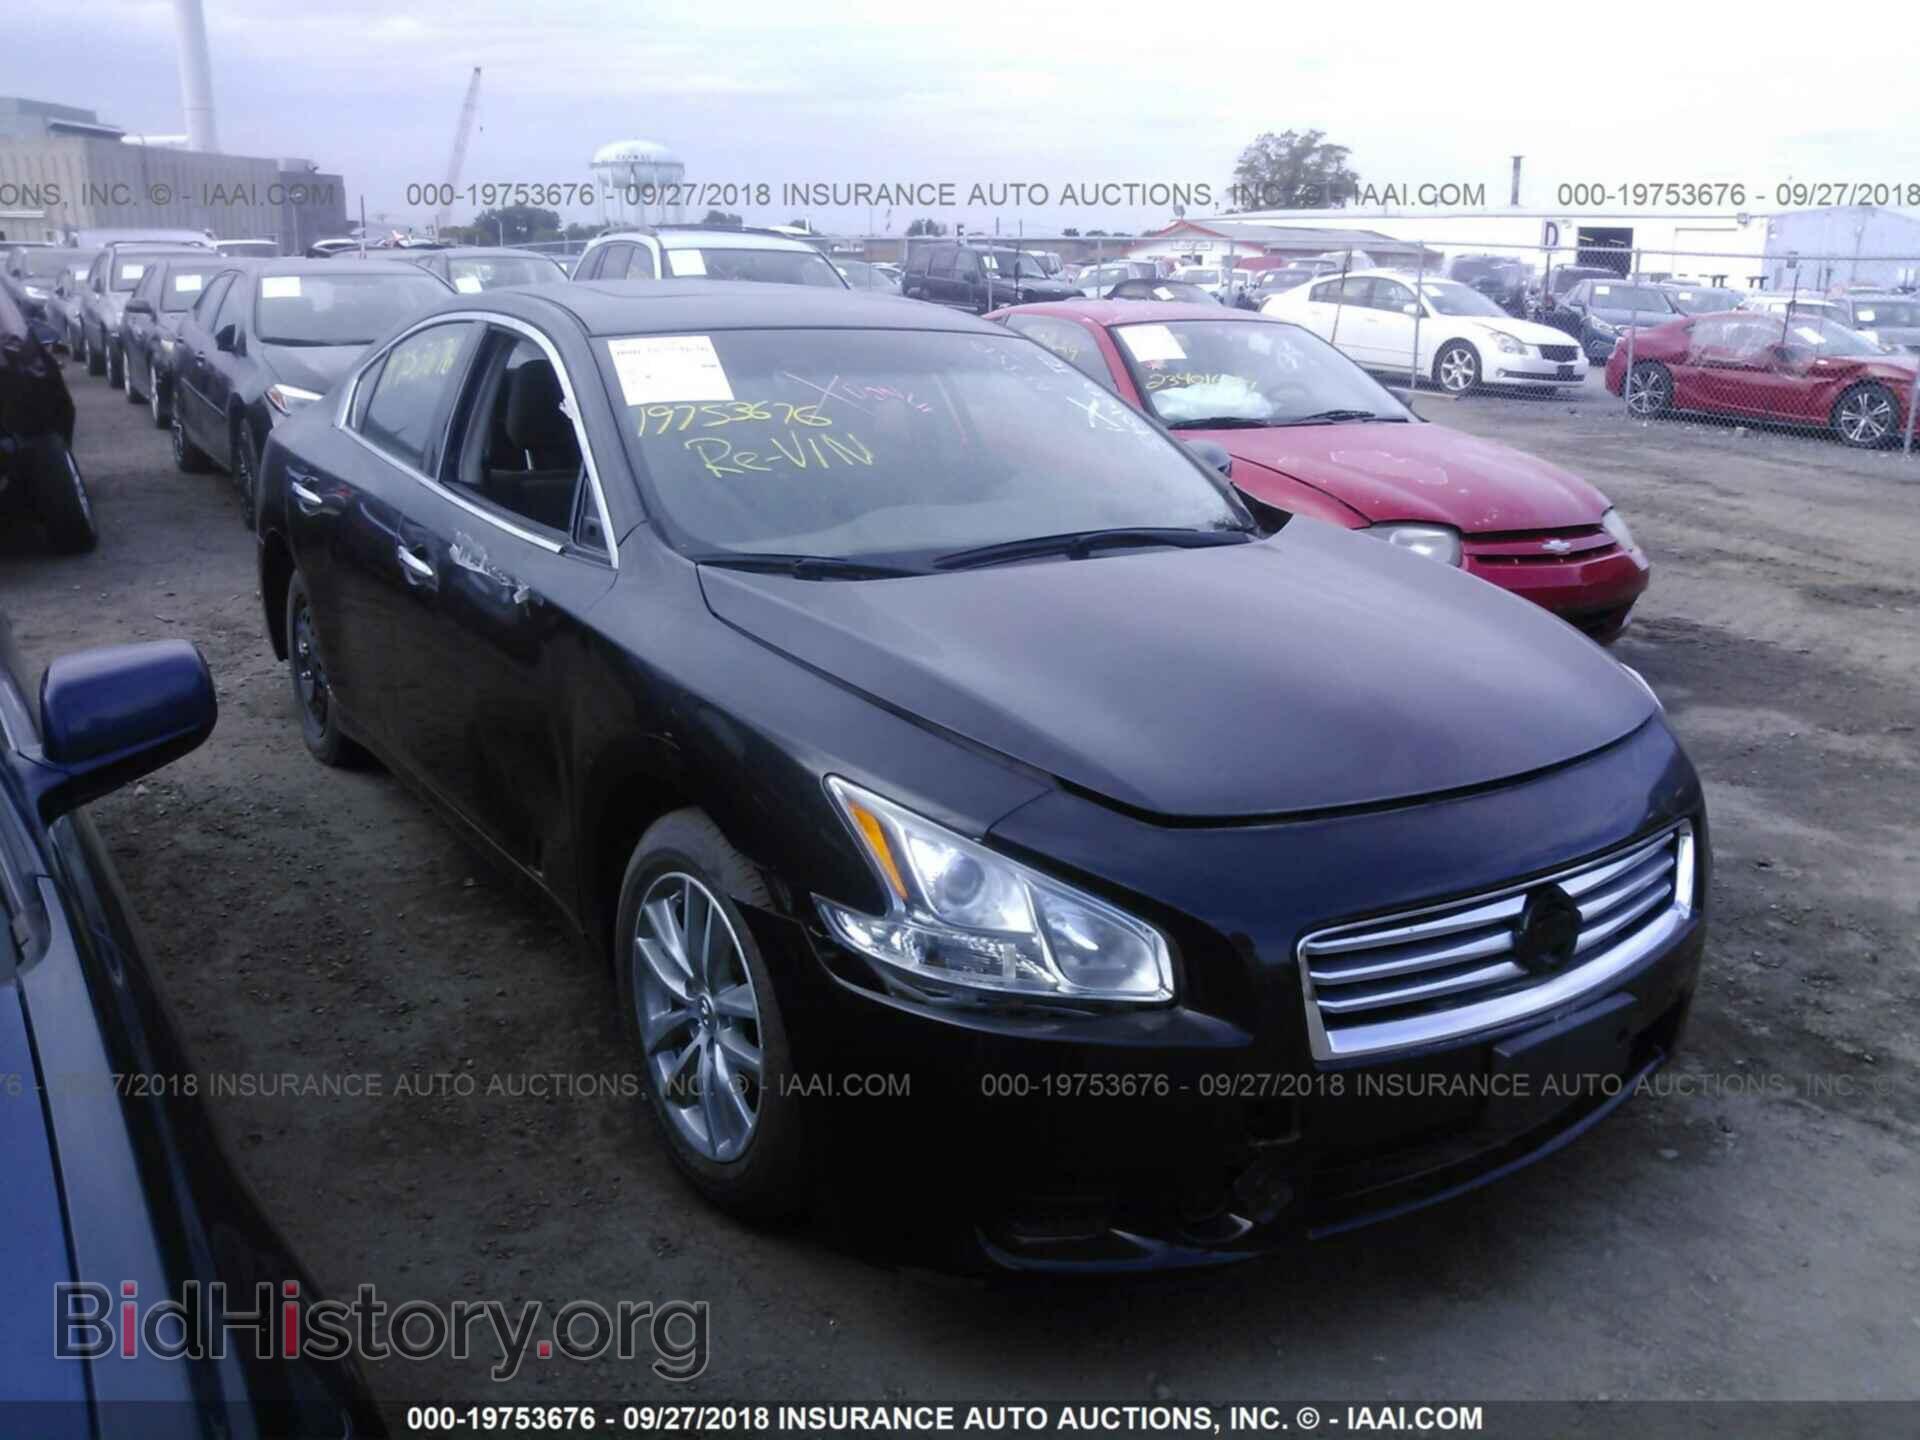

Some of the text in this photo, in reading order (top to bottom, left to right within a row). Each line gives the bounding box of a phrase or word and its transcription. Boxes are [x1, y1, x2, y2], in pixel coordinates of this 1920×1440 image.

[1545, 221, 1559, 246] D
[638, 401, 833, 438] 19753676
[684, 430, 874, 478] Re-VIN
